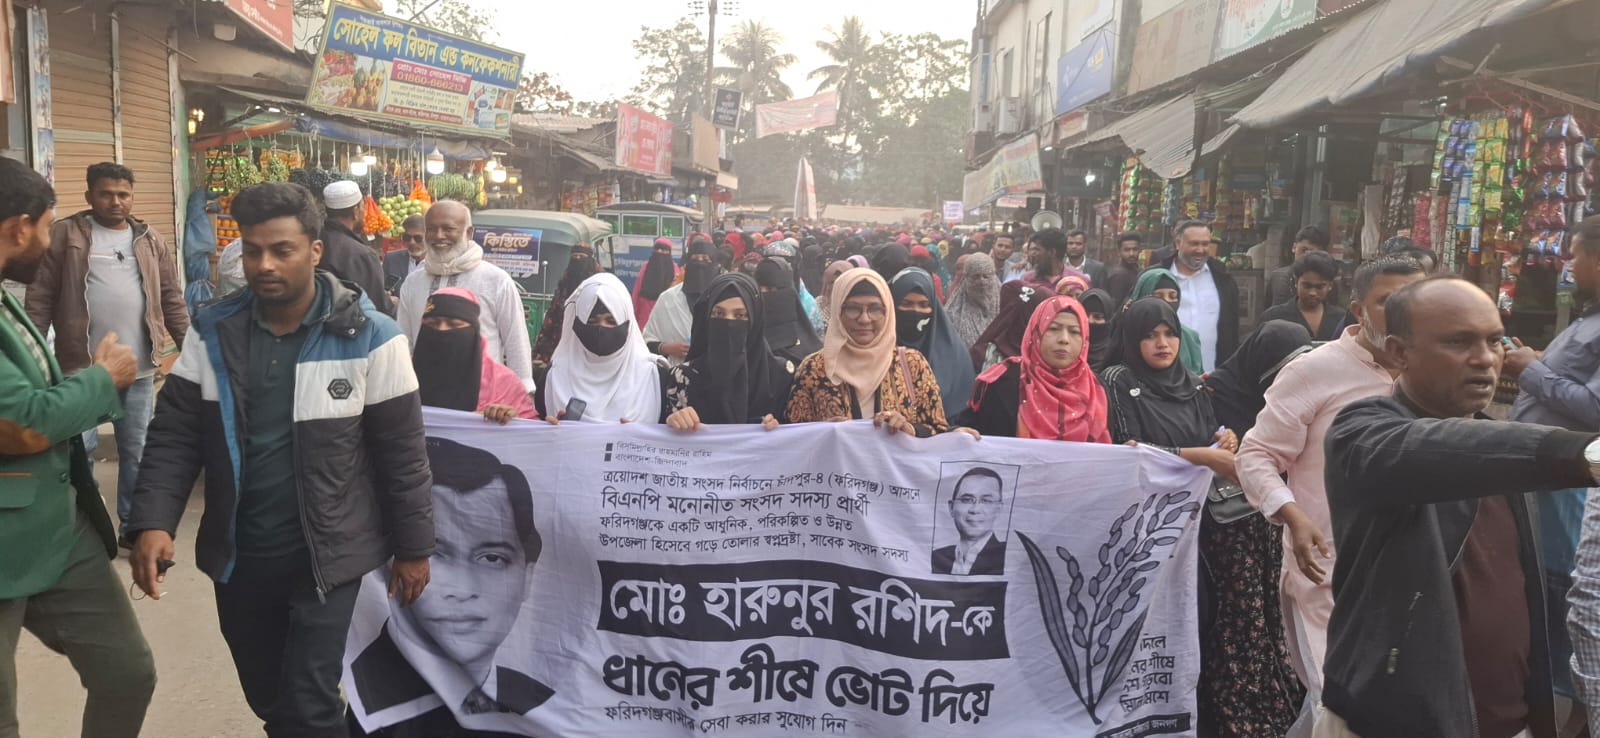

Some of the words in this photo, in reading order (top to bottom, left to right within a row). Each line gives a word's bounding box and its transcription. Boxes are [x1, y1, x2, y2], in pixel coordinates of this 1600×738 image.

[333, 17, 381, 52] সোহেল
[405, 27, 439, 64] বিতান
[601, 485, 662, 512] বিএনপি
[666, 492, 736, 514] মনোনীত
[740, 493, 785, 511] সংসদ
[789, 491, 833, 510] সদস্য
[836, 493, 871, 516] প্রার্থী
[603, 470, 648, 485] ত্রয়োদশ
[652, 471, 689, 488] জাতীয়
[692, 478, 725, 491] সংসদ
[729, 474, 773, 491] নির্বাচনে
[889, 484, 921, 500] আসনে
[600, 512, 664, 532] ফরিদগঞ্জকে
[668, 518, 701, 533] একটি
[757, 512, 809, 529] পরিকল্পিত
[814, 515, 822, 527] ও
[826, 514, 854, 532] উন্নত
[599, 533, 647, 551] উপজেলা
[651, 535, 690, 552] হিসেবে
[695, 540, 718, 553] গড়ে
[722, 536, 760, 550] তোলার
[810, 533, 845, 549] সাবেক
[848, 538, 878, 557] সংসদ
[881, 547, 909, 562] সদস্য
[610, 577, 686, 625] মোঃ
[698, 577, 840, 636] হারুনুর
[848, 578, 996, 647] রশিদ-কে
[602, 654, 721, 711] ধানের
[726, 642, 820, 703] শীষে
[825, 665, 914, 716] ভোট
[918, 668, 995, 725] দিয়ে
[604, 700, 696, 732] ফরিদগঞ্জবাসীর
[700, 714, 730, 733] সেবা
[735, 711, 772, 726] করার
[775, 711, 816, 731] সুযোগ
[821, 712, 848, 734] দিন
